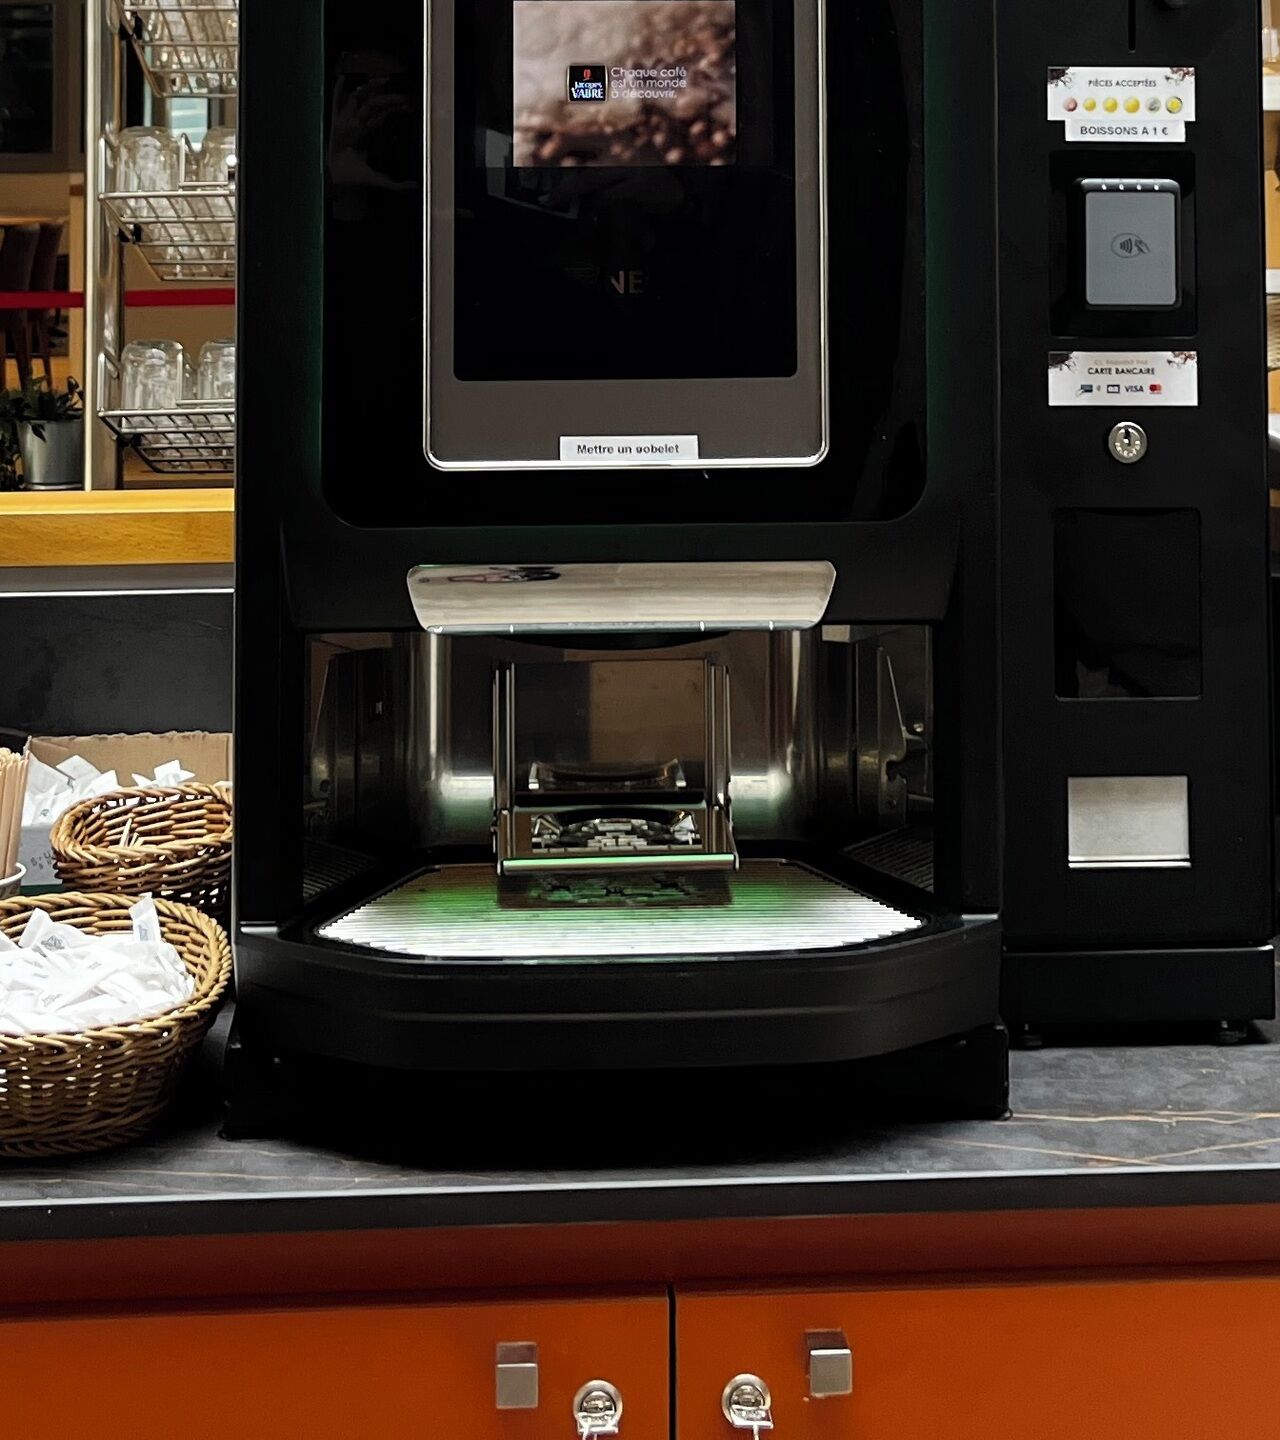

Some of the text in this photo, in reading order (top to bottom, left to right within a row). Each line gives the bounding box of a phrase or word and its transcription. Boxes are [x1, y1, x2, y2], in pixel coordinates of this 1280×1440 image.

[630, 80, 644, 88] un
[646, 78, 688, 88] monde
[1080, 126, 1138, 135] BOISSONS
[1153, 126, 1158, 135] 1
[1161, 126, 1169, 136] €
[1087, 367, 1156, 375] CARTE BANCAIRE
[1124, 384, 1145, 393] VISA
[577, 443, 680, 455] Mettre un gobelet
